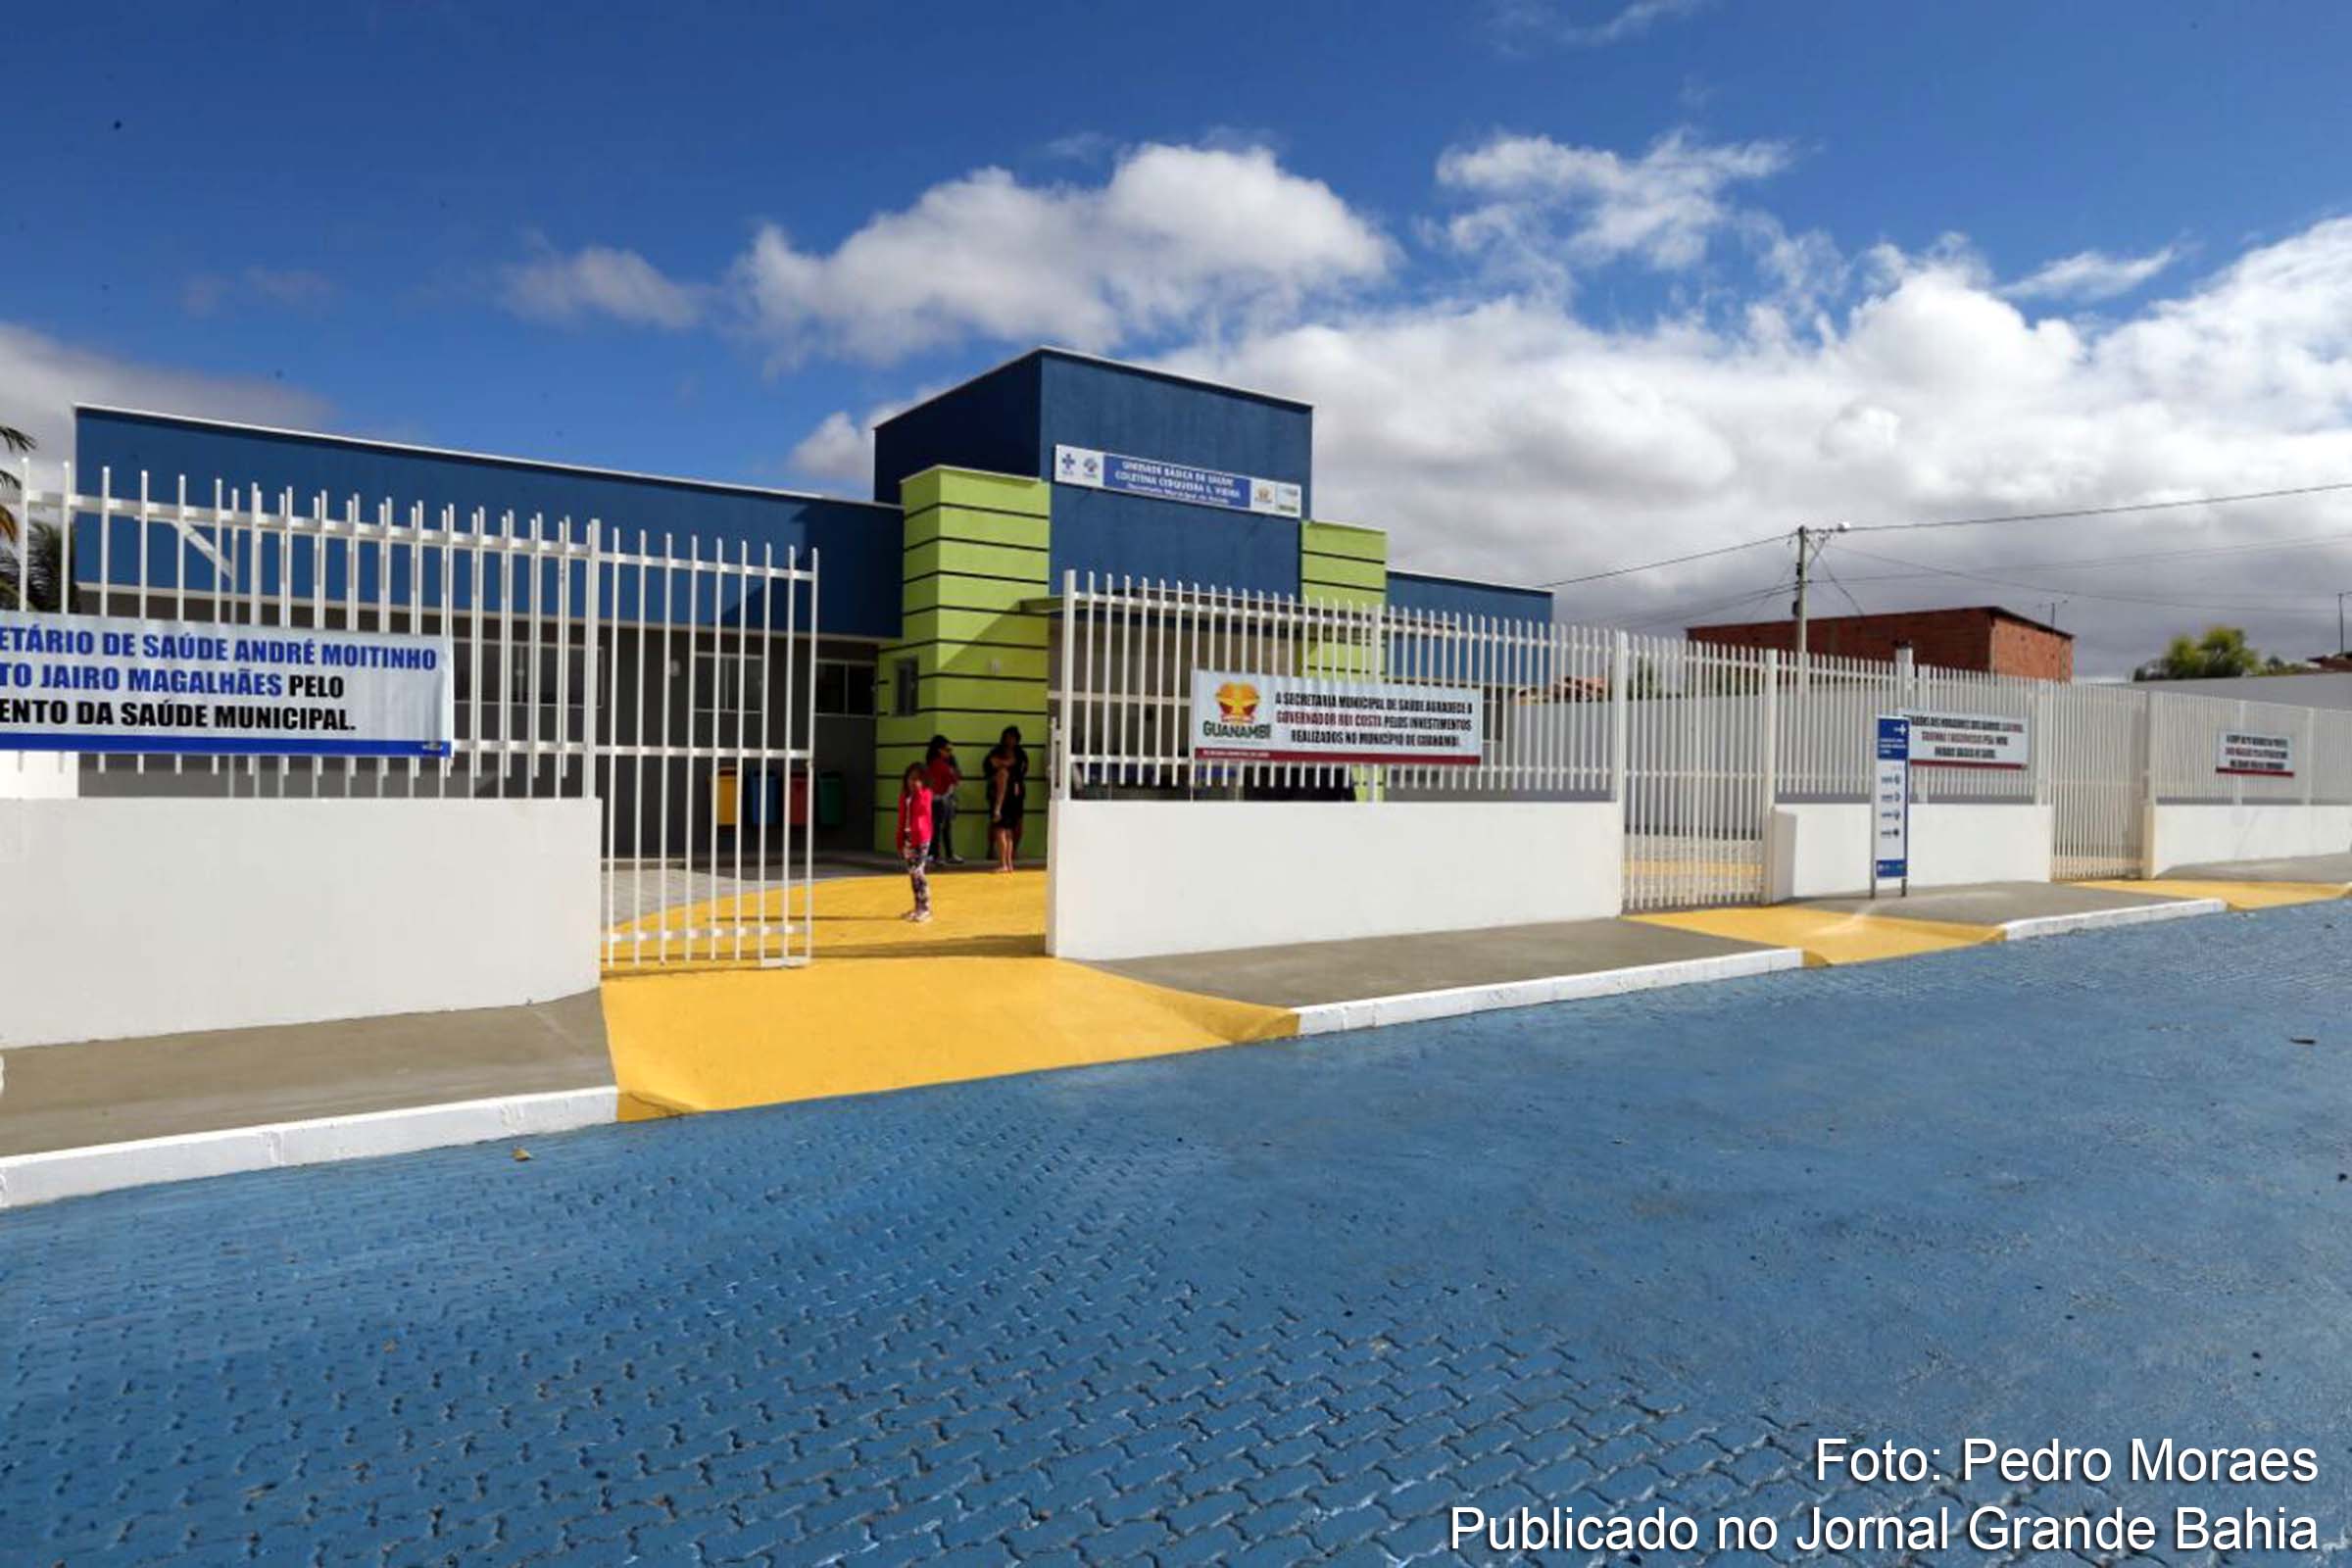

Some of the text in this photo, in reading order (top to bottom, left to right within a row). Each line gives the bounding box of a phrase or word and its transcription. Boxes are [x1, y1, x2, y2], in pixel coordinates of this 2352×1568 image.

[0, 623, 436, 670] ETÁRIO DE SAÚDE ANDRÉ MOITINHO
[40, 664, 120, 690] JAIRO
[127, 668, 281, 696] MAGALHÃES
[289, 674, 344, 699] PELO
[1283, 692, 1337, 708] SECRETARIA
[1339, 695, 1384, 710] MUNICIPAL
[1387, 698, 1396, 710] DE
[0, 699, 356, 730] ENTO DA SAÚDE MUNICIPAL.
[1277, 710, 1472, 731] GOVERNADOR RUI COSTA PELOS INVESTIMENTOS
[1202, 720, 1271, 739] GUANAMBI
[1292, 729, 1344, 744] REALIZADOS
[1406, 733, 1415, 746] DE
